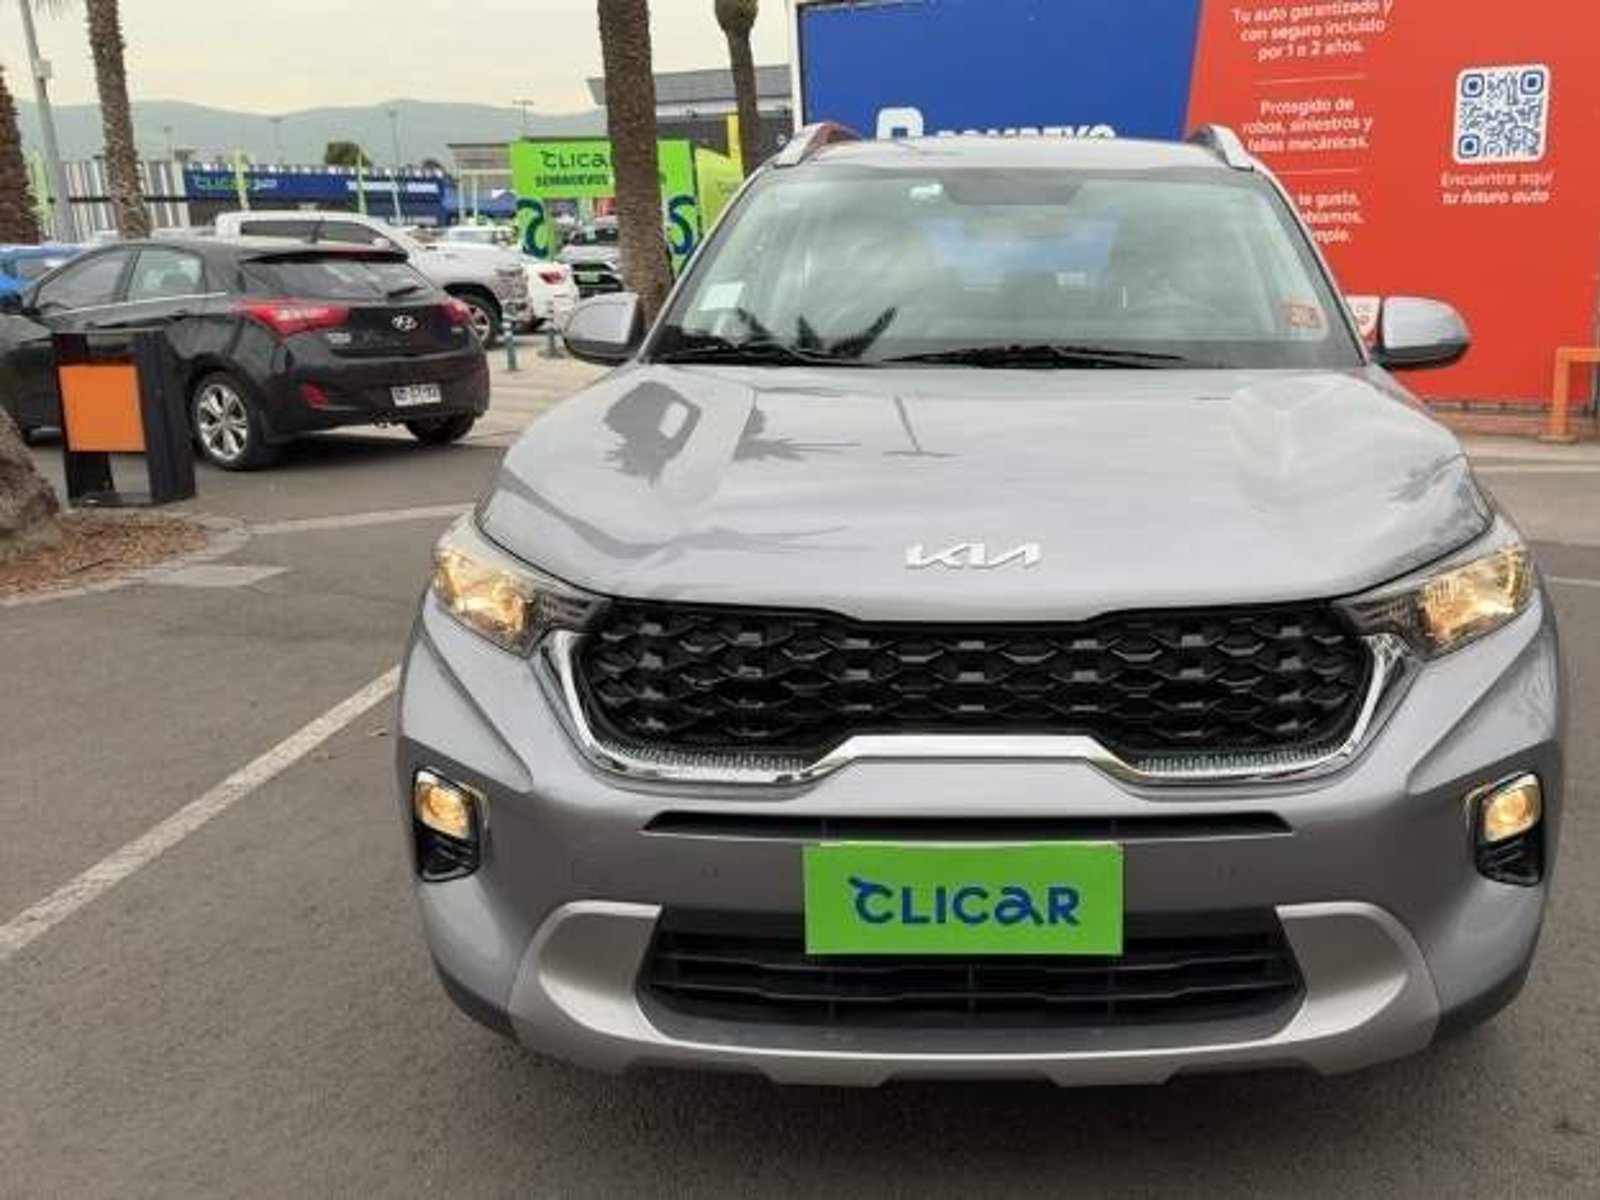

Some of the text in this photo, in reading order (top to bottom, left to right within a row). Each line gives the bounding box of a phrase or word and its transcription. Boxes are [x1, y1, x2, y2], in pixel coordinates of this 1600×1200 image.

[1232, 0, 1393, 23] Tu auto garantizado y
[1240, 28, 1268, 42] con
[1271, 24, 1322, 43] seguro
[1258, 46, 1283, 62] por
[1287, 44, 1294, 57] 1
[1260, 97, 1355, 117] Protegido de
[1289, 114, 1361, 132] siniestros
[1363, 116, 1374, 132] y
[539, 150, 609, 169] CLICA
[1440, 171, 1516, 187] Encuentra
[1442, 188, 1551, 205] tu futuro auto
[904, 543, 1041, 570] KIA
[847, 876, 1081, 927] CLICAR
